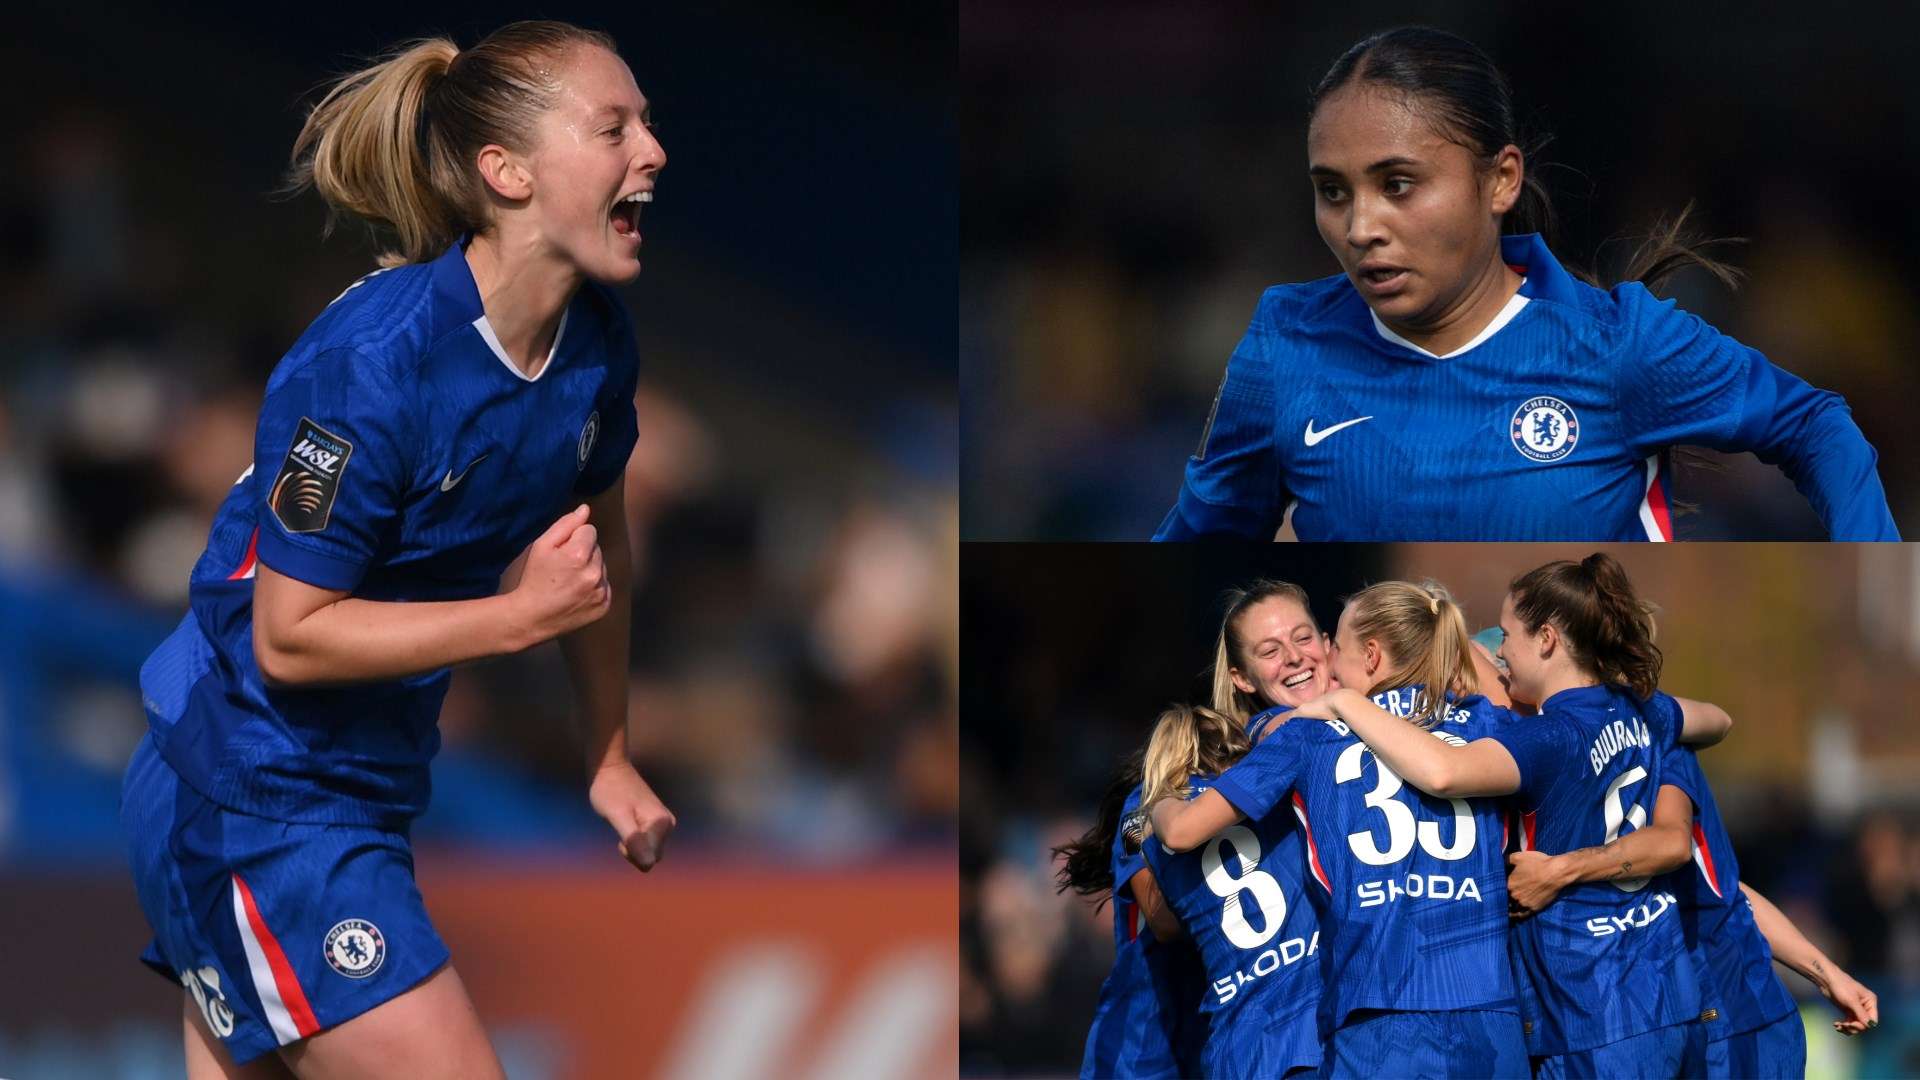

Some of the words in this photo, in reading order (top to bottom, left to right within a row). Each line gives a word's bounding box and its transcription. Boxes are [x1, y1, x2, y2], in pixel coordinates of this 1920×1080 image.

[1524, 400, 1567, 414] CHELSEA
[293, 439, 339, 473] WSL
[1201, 824, 1288, 950] 8
